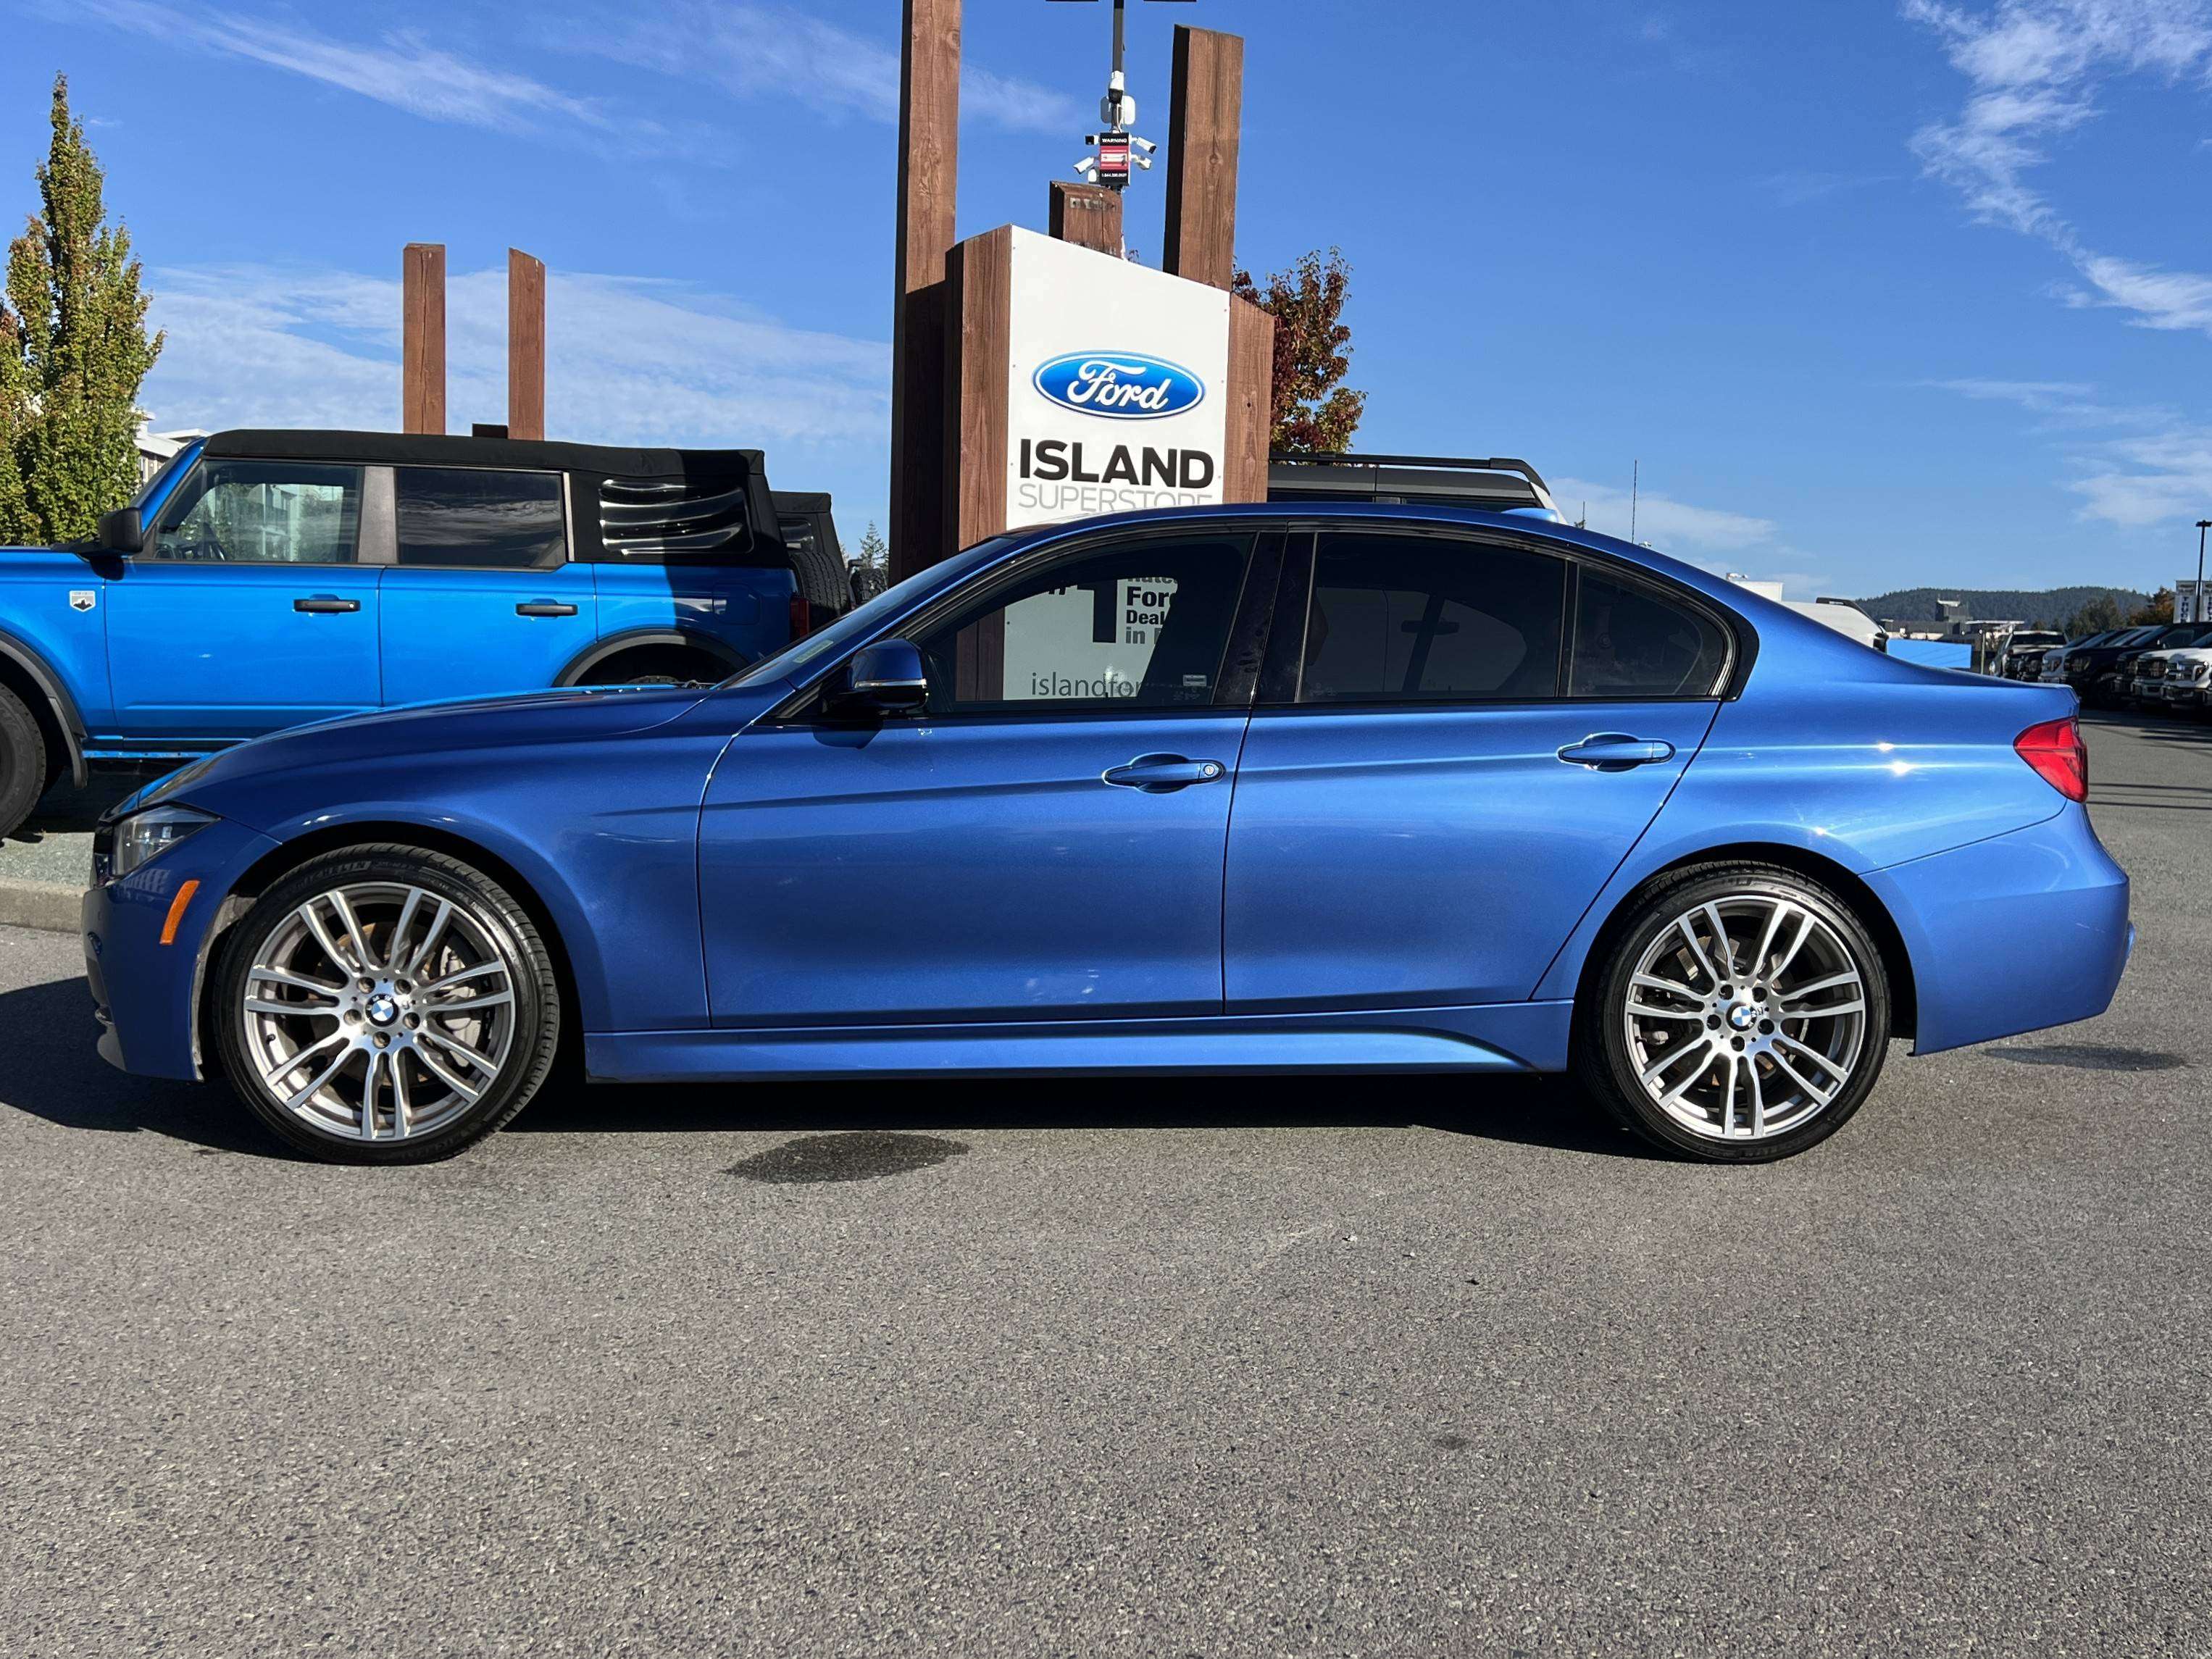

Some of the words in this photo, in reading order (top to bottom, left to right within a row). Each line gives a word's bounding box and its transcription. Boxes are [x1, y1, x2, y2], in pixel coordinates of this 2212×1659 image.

[1067, 360, 1172, 410] Ford
[1019, 438, 1214, 489] ISLAND
[1125, 626, 1145, 644] in
